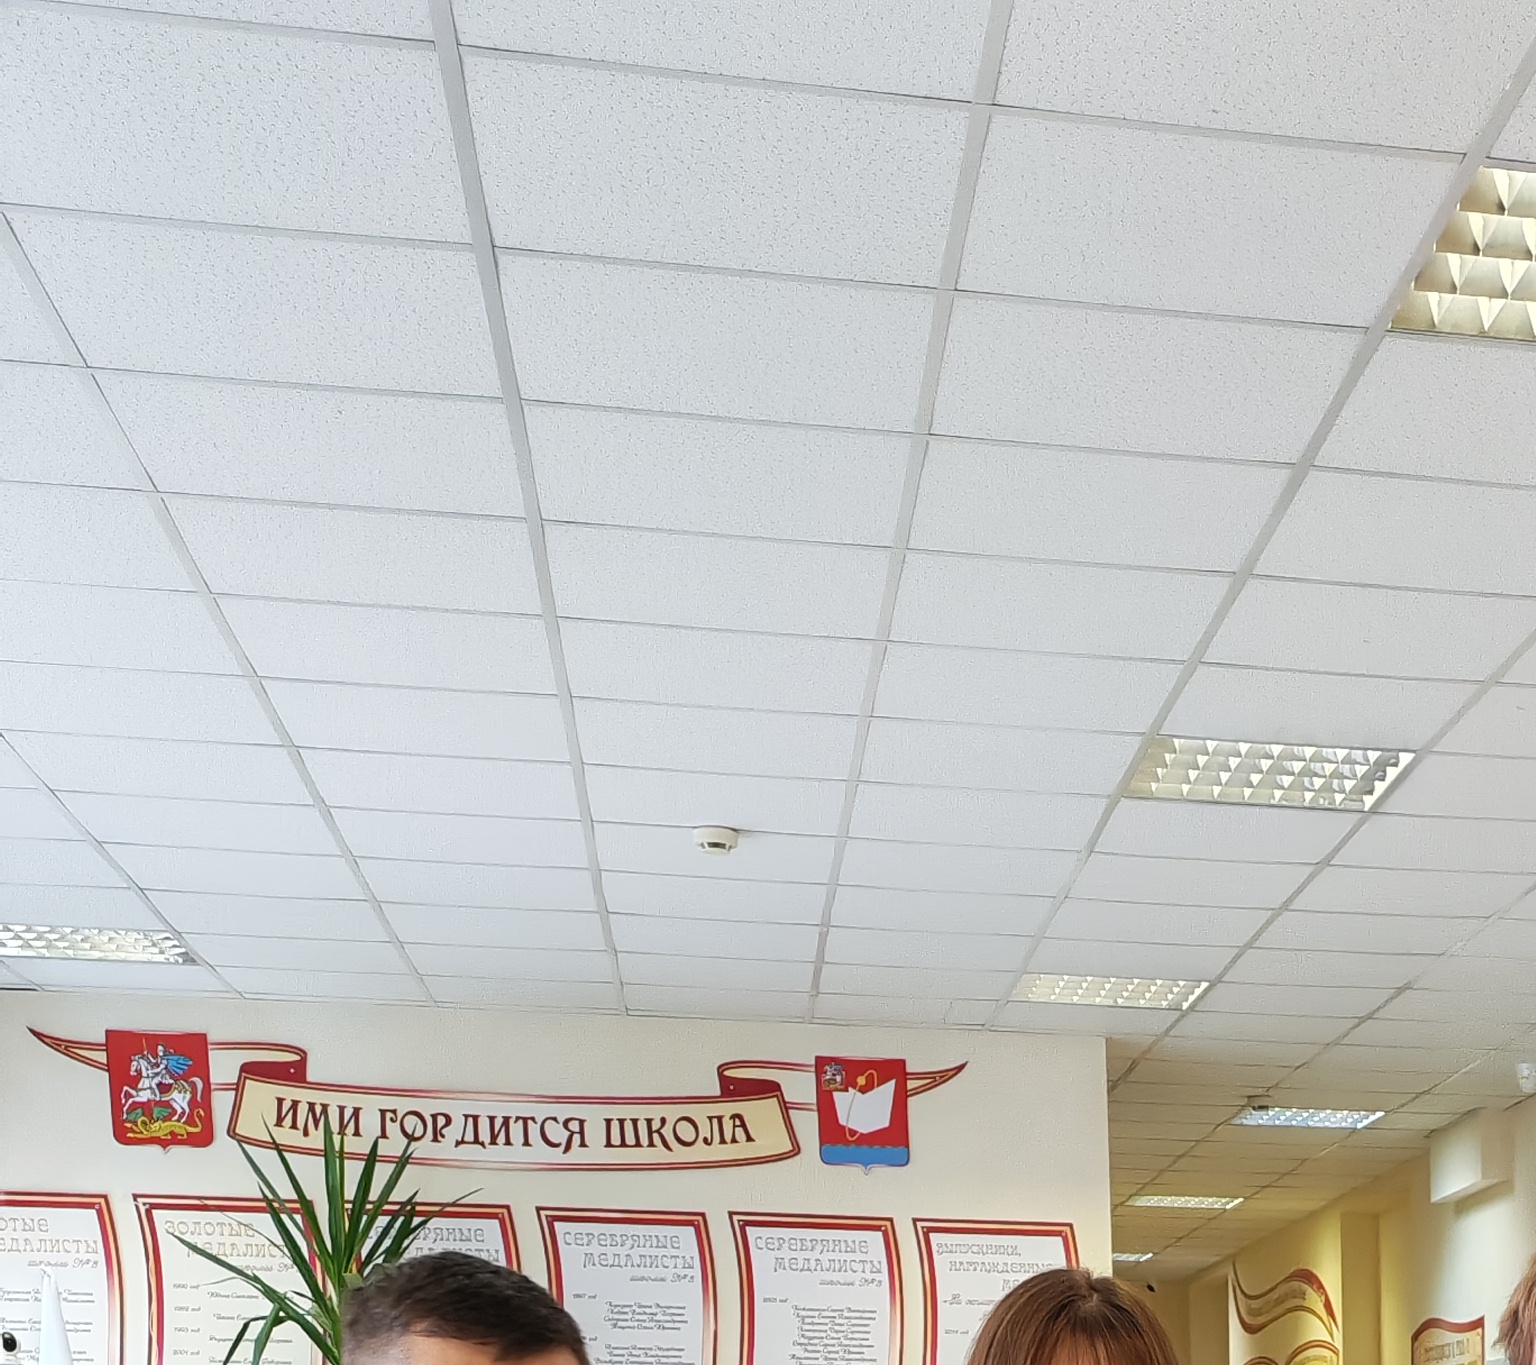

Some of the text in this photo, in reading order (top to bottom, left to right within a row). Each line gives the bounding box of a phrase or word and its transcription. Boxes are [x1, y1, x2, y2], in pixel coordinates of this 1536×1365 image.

[274, 1096, 756, 1154] ИМИ ГОРДИТСЯ ШКОЛА
[164, 1220, 255, 1238] ЗОЛОТЫЕ
[563, 1231, 681, 1250] СЕРЕБРЯНЫЕ
[754, 1236, 869, 1255] СЕРЕБРЯНЫЕ
[583, 1252, 695, 1269] МЕДАЛИСТЫ
[774, 1257, 883, 1274] МЕДАЛИСТЫ
